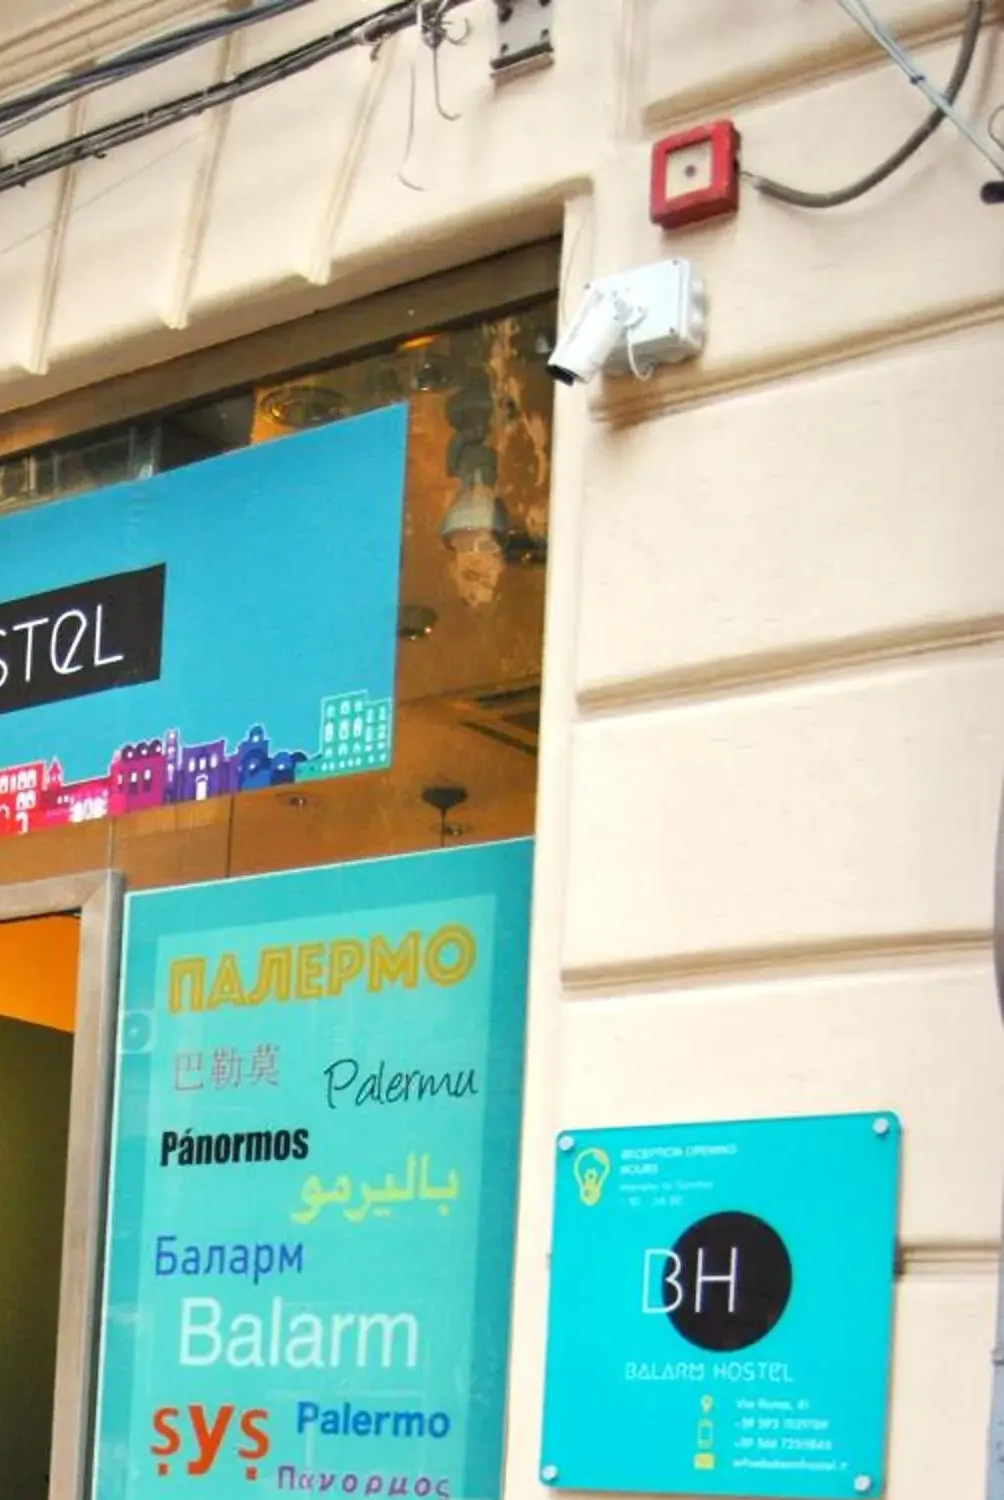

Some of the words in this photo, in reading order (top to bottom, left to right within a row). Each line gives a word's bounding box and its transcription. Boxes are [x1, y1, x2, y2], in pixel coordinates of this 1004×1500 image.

[167, 923, 477, 1014] ПАЛЕРМО
[323, 1058, 479, 1109] Palermu
[159, 1127, 310, 1167] Pánormos
[154, 1235, 304, 1286] Баларм
[642, 1246, 738, 1314] BH
[178, 1295, 420, 1369] Balarm
[625, 1361, 705, 1381] BALARM
[296, 1400, 451, 1440] Palermo
